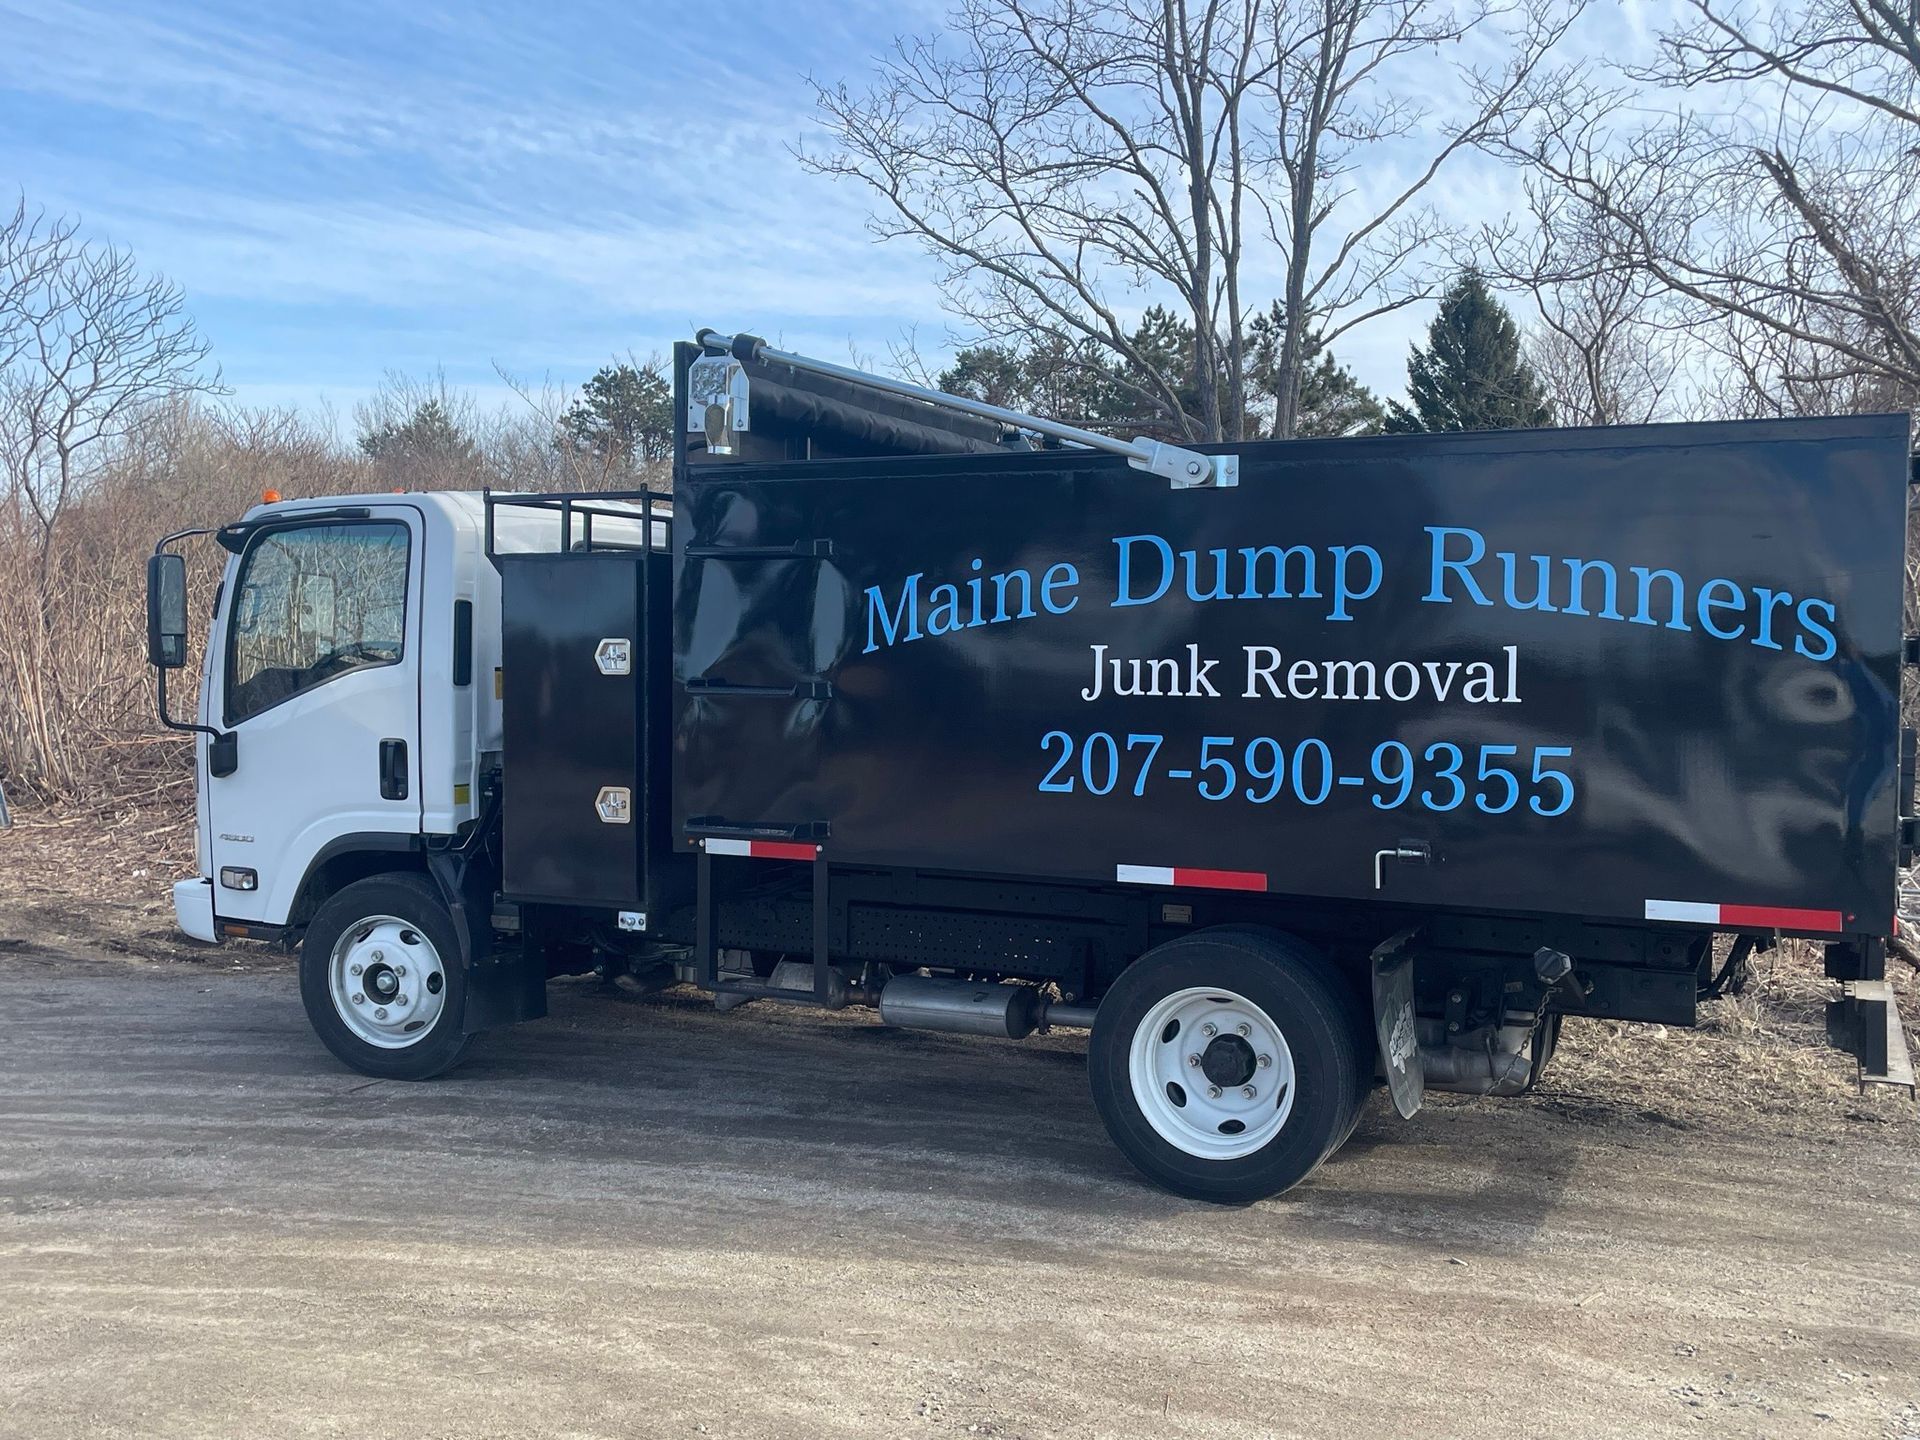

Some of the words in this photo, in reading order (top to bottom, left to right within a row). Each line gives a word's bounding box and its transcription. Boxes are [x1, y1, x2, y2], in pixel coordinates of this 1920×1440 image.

[862, 558, 1080, 655] Maine
[1110, 534, 1384, 622] Dump
[1421, 526, 1838, 662] Runners
[1081, 643, 1221, 702] Junk
[1241, 645, 1522, 703] Removal
[1038, 730, 1575, 817] 207-590-9355
